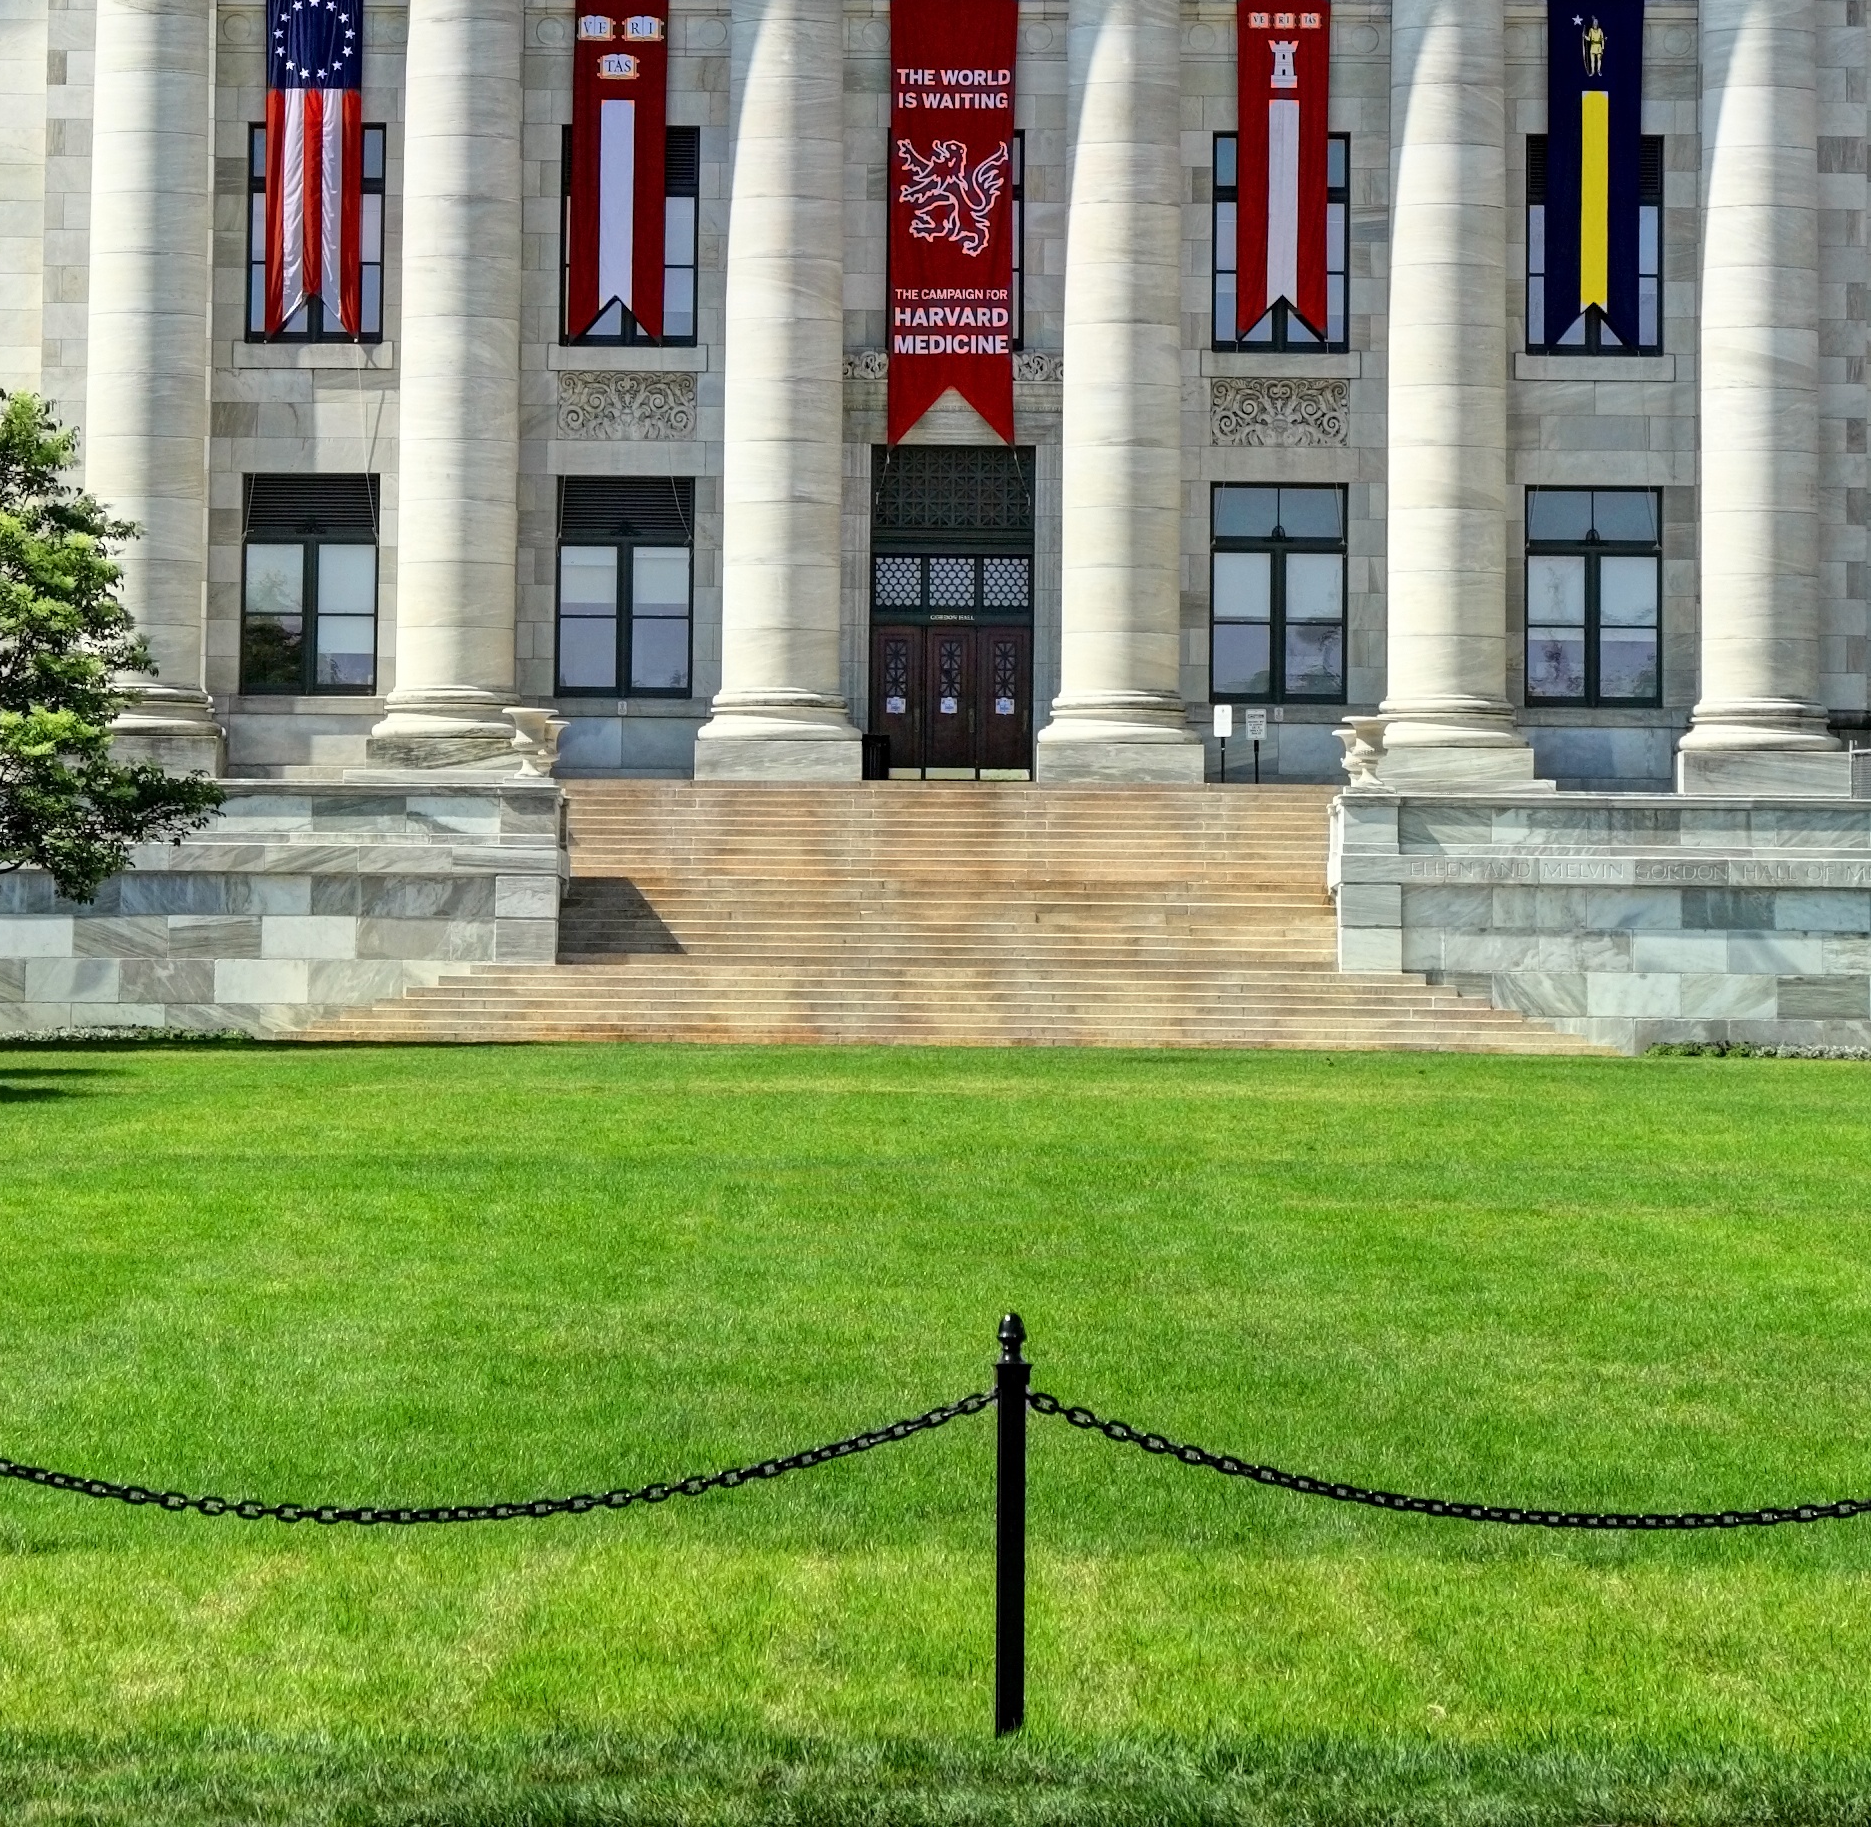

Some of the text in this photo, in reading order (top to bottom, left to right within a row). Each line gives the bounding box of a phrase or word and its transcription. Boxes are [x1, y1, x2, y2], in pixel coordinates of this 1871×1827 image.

[584, 21, 654, 35] VE RI
[605, 59, 632, 73] TAS
[897, 69, 1011, 86] THE WORLD
[898, 92, 1009, 109] IS WAITING
[895, 289, 1008, 300] THE CAMPAIGN FOR
[894, 306, 1009, 327] HARVARD
[894, 335, 1009, 354] MEDICINE
[1410, 861, 1474, 877] ELLEN
[1484, 862, 1531, 878] AND
[1543, 863, 1623, 879] MELVIN
[1635, 864, 1728, 880] GORDON
[1742, 865, 1797, 881] HALL
[1806, 866, 1835, 881] OF
